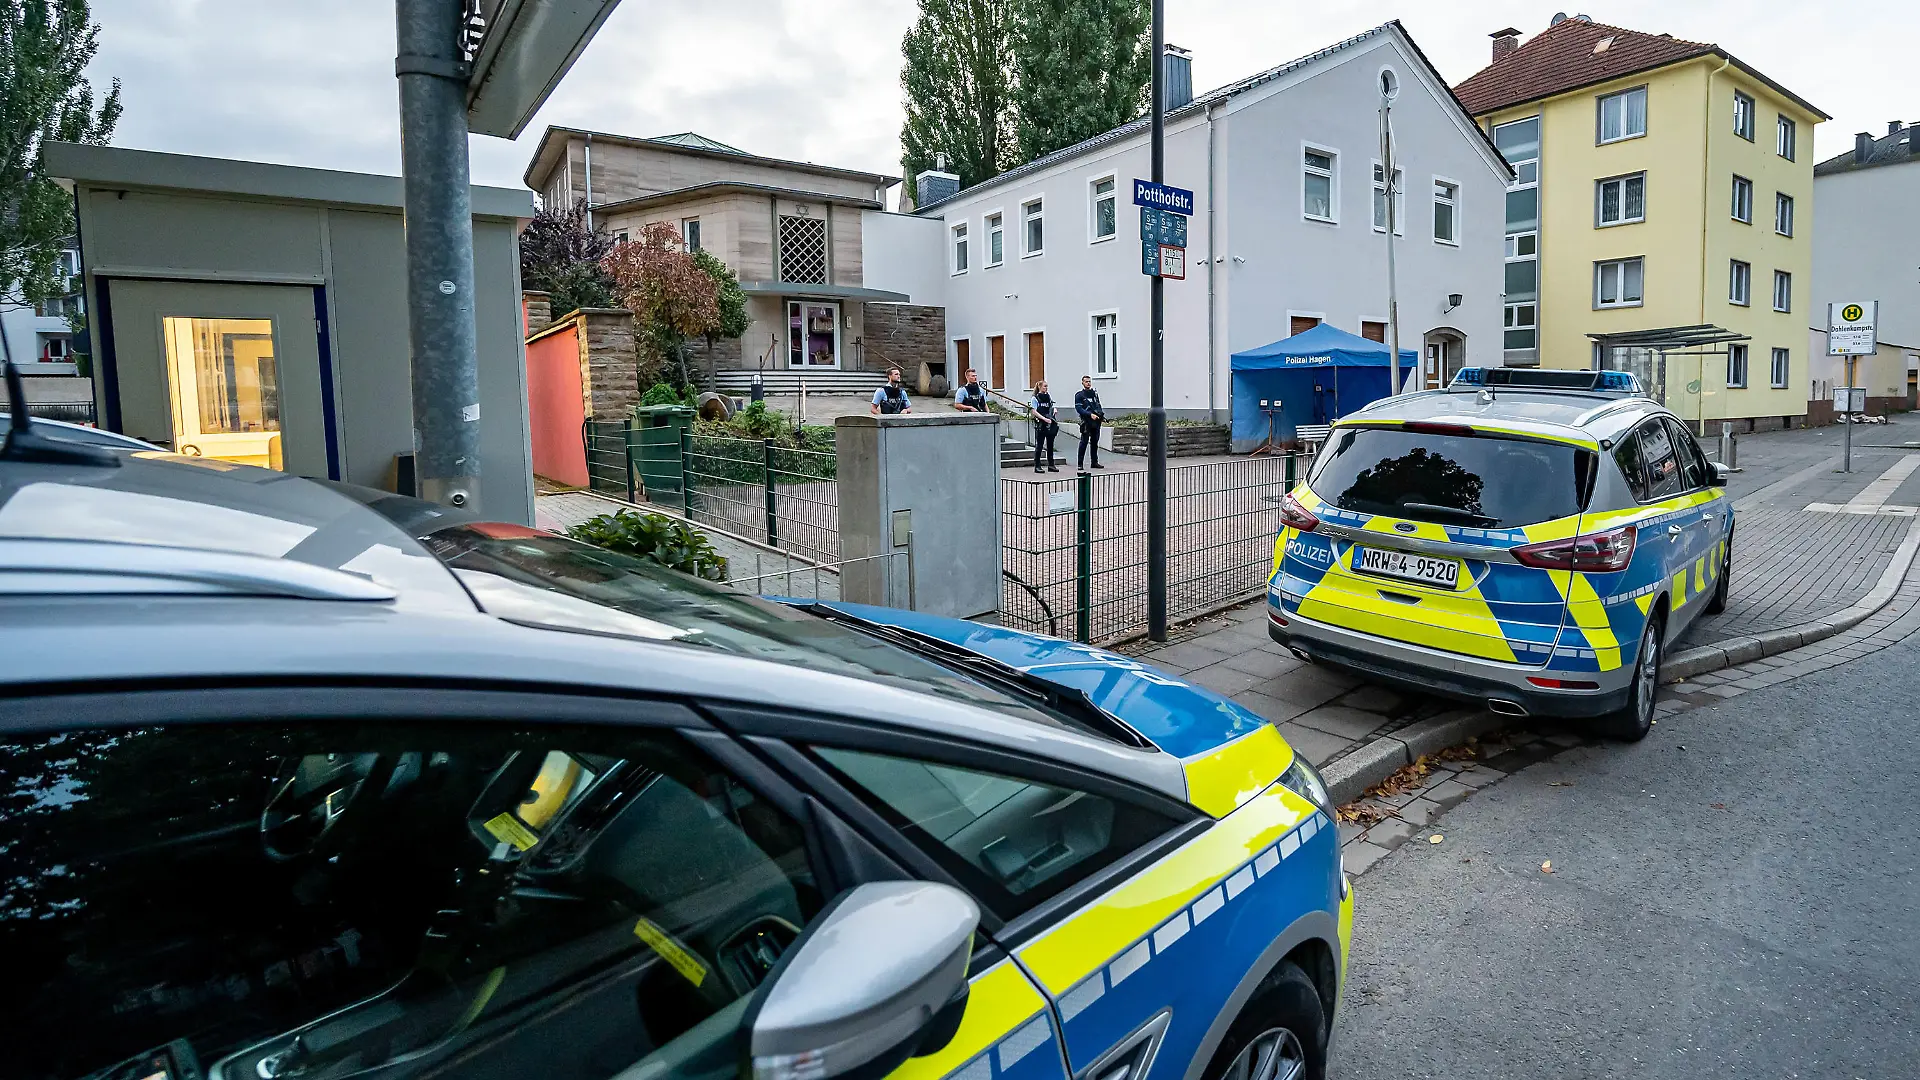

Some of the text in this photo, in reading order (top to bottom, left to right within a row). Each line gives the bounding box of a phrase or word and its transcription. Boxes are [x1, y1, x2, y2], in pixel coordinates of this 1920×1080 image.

[1137, 184, 1191, 210] Potthofstr.
[1847, 308, 1858, 318] H
[1309, 355, 1331, 365] Hagen
[1286, 540, 1331, 564] POLIZEI
[1362, 549, 1456, 581] NRW 4-9520
